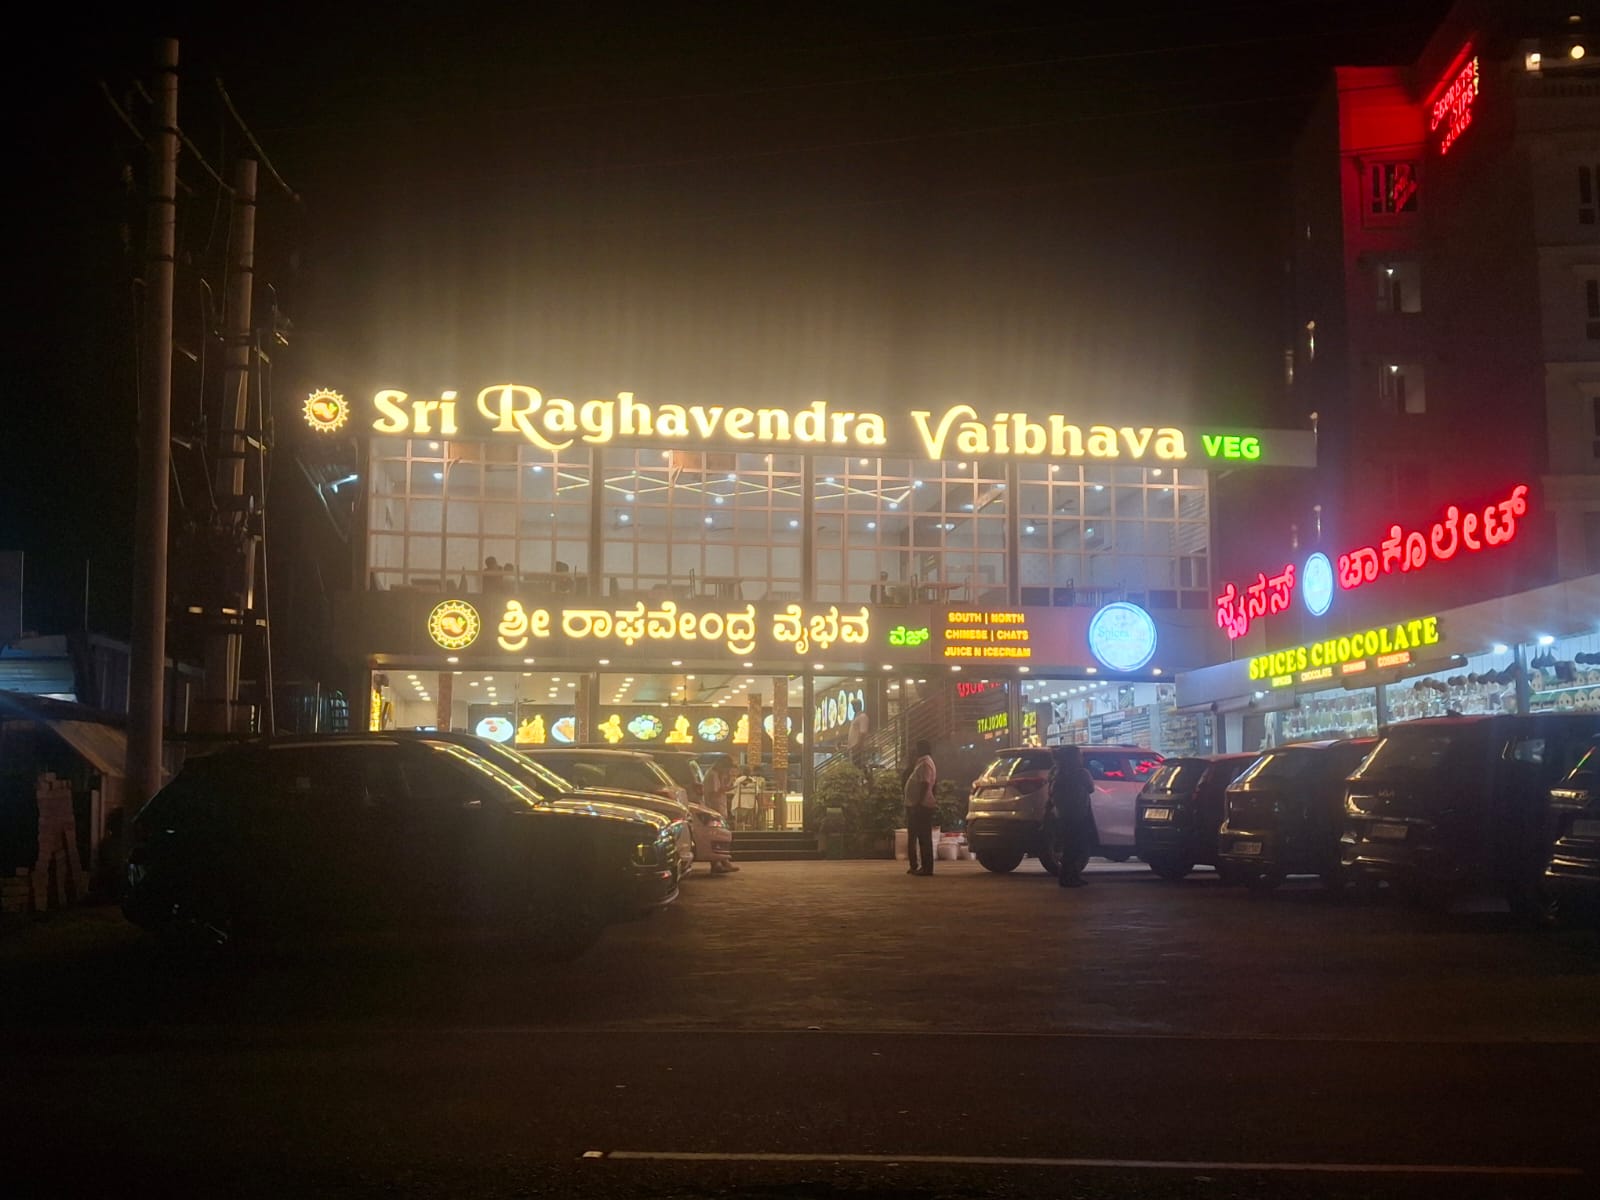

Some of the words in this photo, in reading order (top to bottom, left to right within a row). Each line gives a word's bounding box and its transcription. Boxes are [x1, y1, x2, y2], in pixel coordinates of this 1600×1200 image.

[373, 389, 458, 435] Sri
[477, 384, 887, 451] Raghavendra
[911, 405, 1188, 461] Vaibhava
[1201, 434, 1262, 460] VEG
[498, 600, 549, 651] ಶ್ರೀ
[562, 601, 756, 655] ರಾಘವೇಂದ್ರ
[773, 605, 869, 655] ವೈಭವ
[948, 612, 982, 623] SOUTH
[991, 612, 1025, 623] NORTH
[945, 629, 988, 640] CHINESE
[996, 630, 1029, 641] CHATS
[944, 646, 973, 657] JUICE
[974, 647, 982, 657] N
[983, 647, 1031, 658] ICECREAM
[1249, 646, 1307, 682] SPICES
[1311, 617, 1439, 667] CHOCOLATE
[1301, 667, 1333, 682] CHOCOLATE
